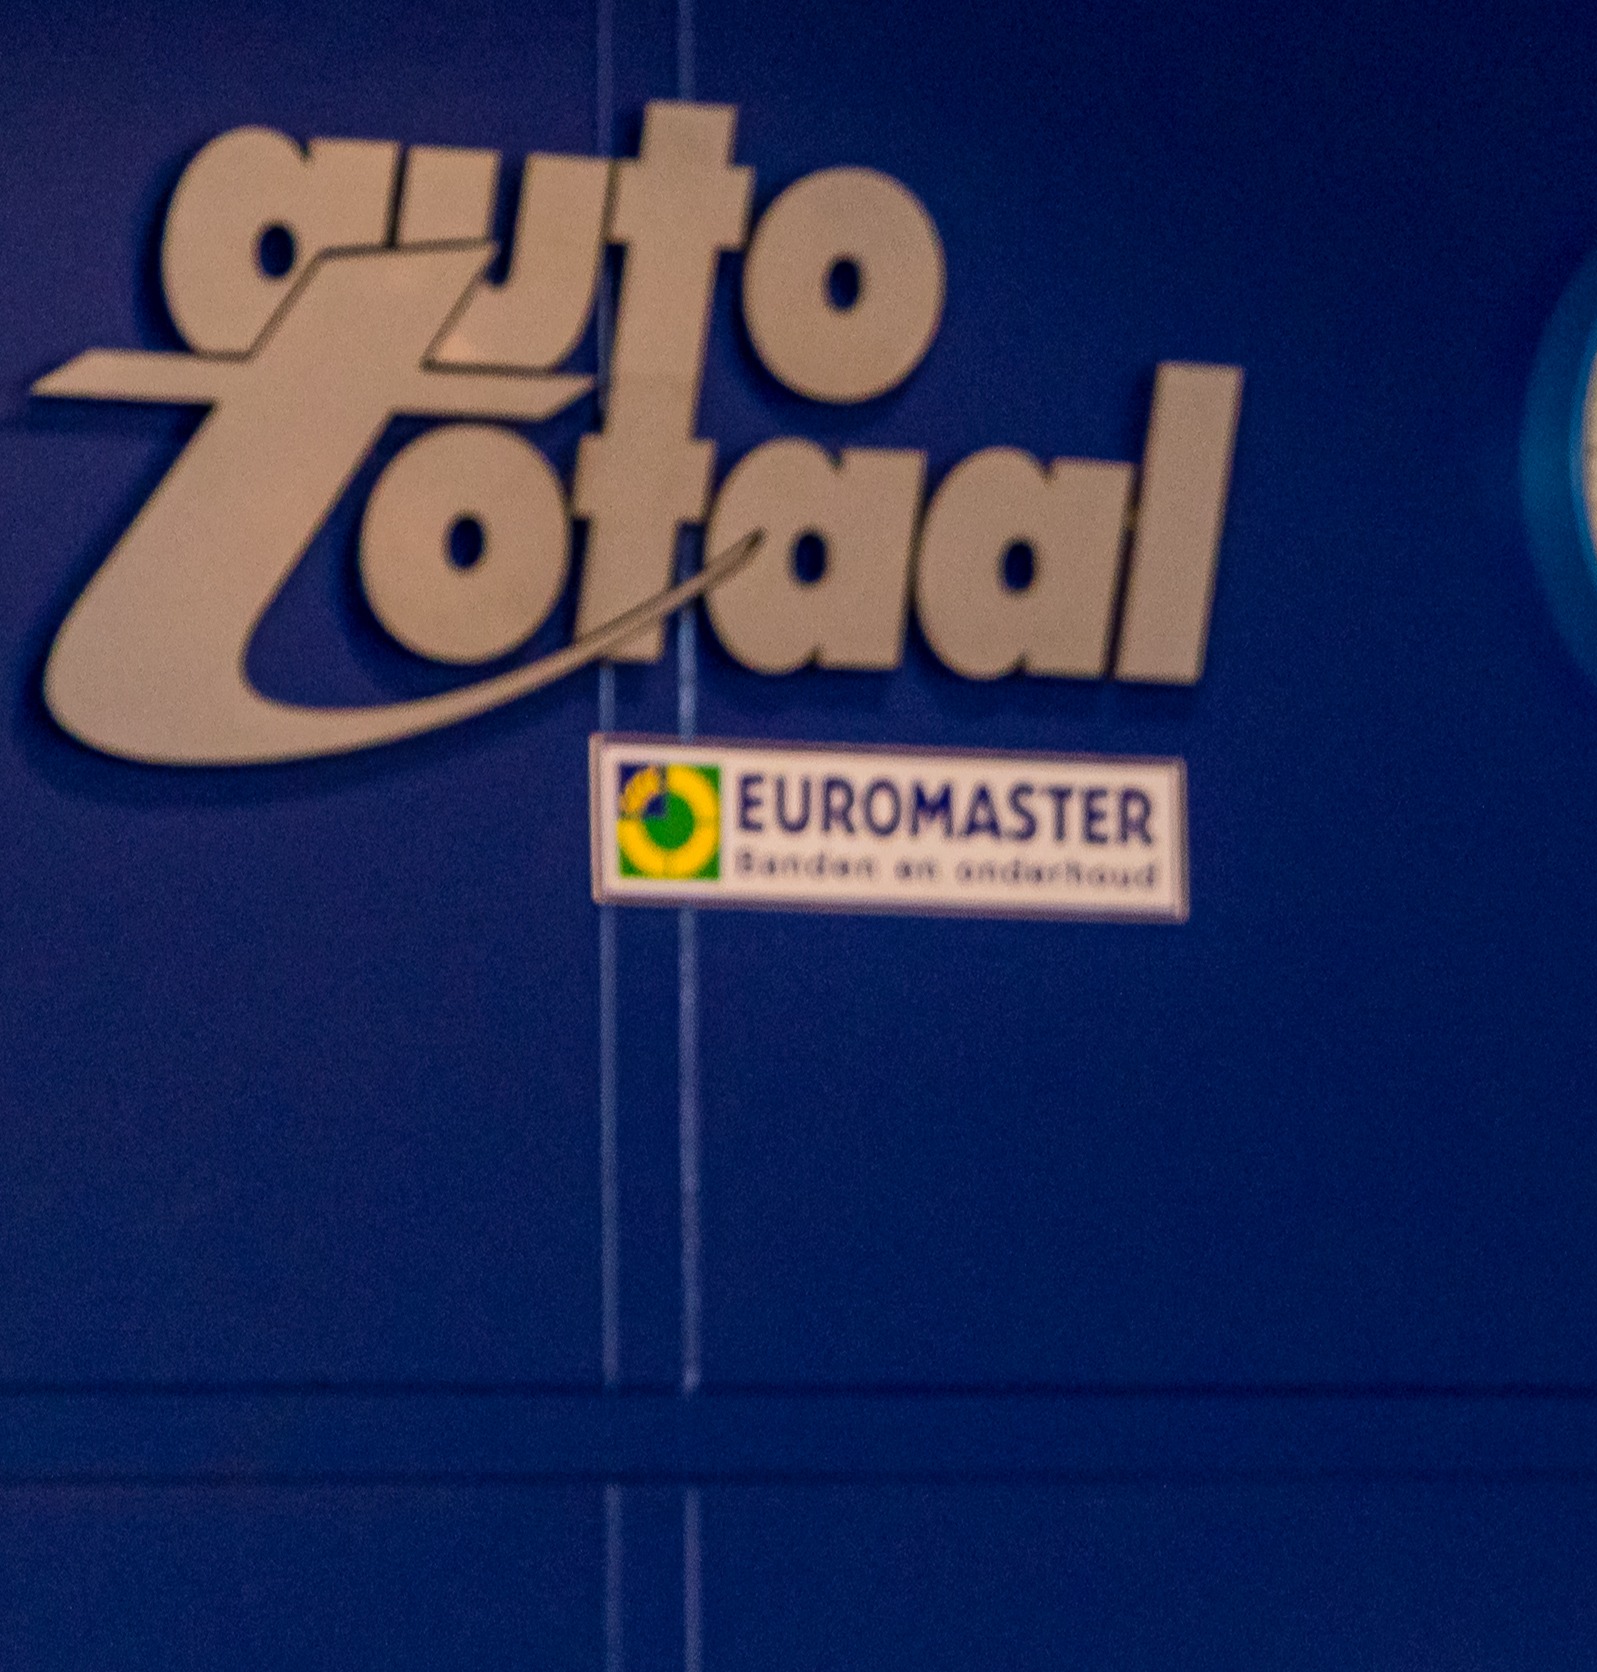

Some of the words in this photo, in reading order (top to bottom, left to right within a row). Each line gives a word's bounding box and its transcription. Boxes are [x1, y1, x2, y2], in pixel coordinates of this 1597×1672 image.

[162, 99, 946, 404] auto
[735, 774, 1154, 845] EUROMASTER
[735, 851, 875, 879] Banden
[896, 855, 936, 878] en
[956, 858, 1158, 890] onderhoud
